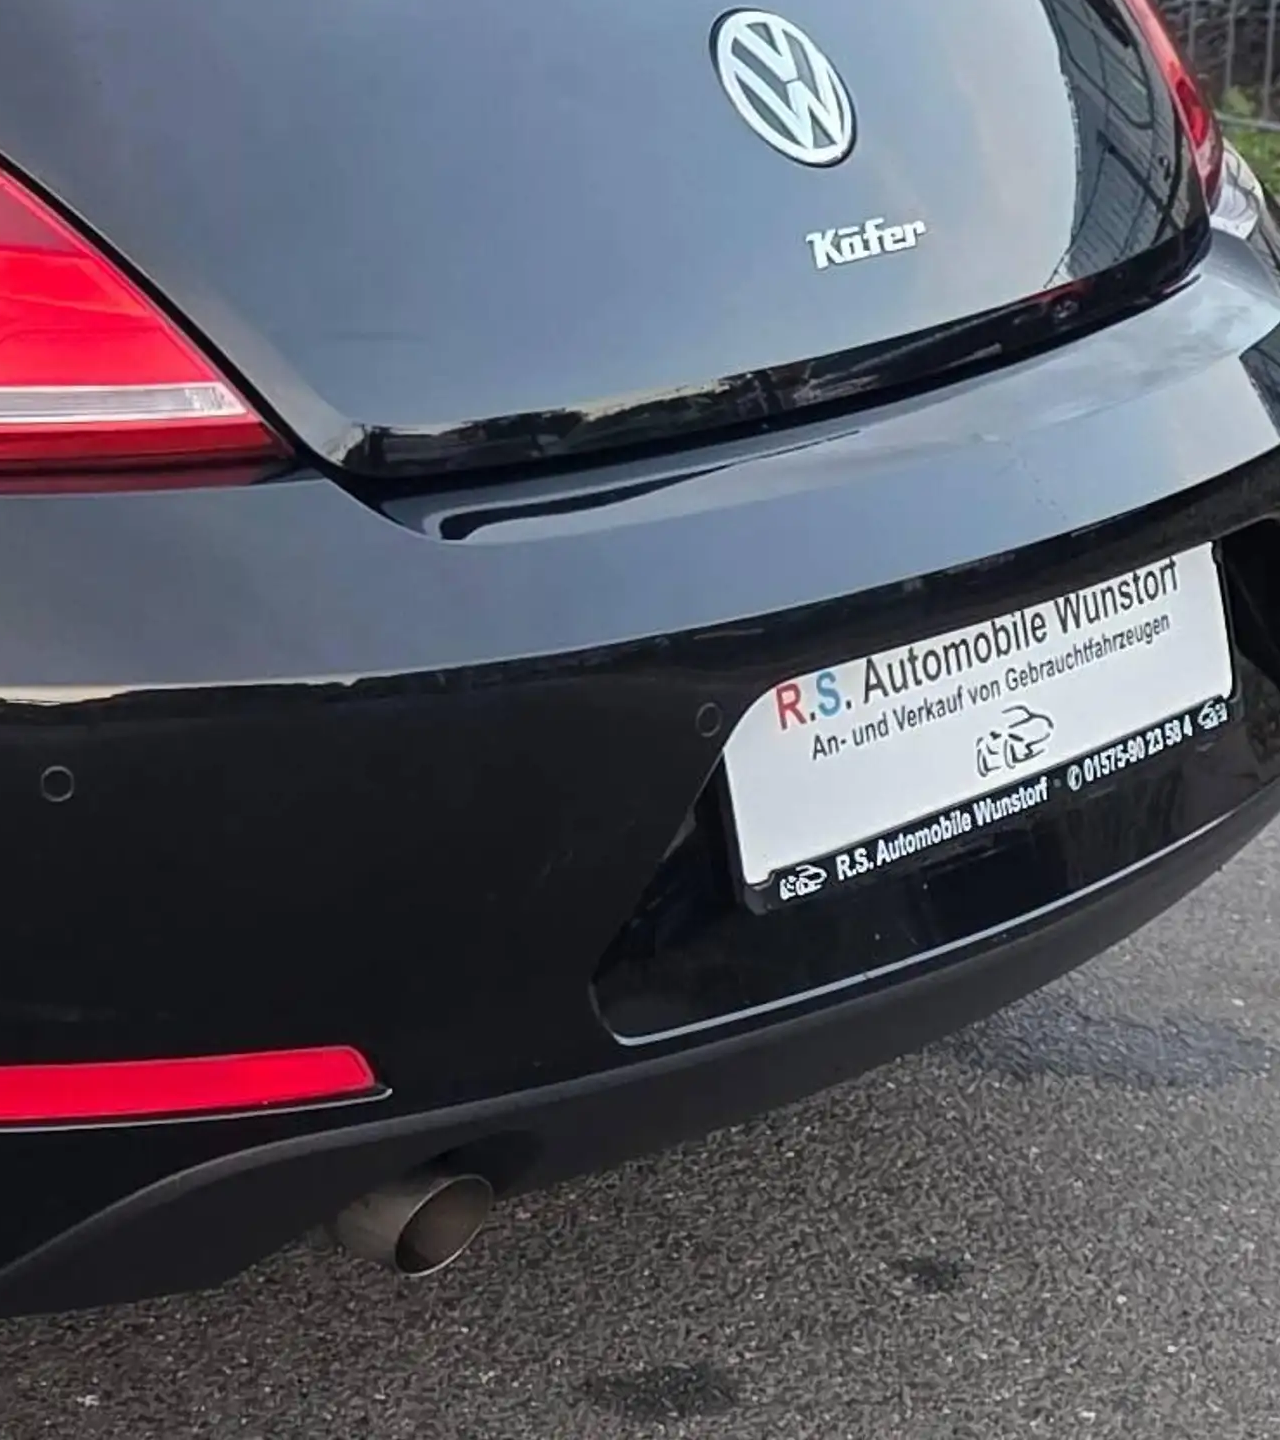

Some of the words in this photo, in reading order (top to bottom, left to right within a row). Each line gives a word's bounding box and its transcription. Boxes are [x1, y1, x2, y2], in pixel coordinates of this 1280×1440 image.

[717, 13, 852, 162] VW
[805, 217, 927, 270] Käfer
[775, 670, 852, 731] R.S.
[863, 610, 1047, 704] Automobile
[1054, 556, 1178, 635] Wunstorf
[812, 733, 847, 761] An-
[852, 711, 889, 747] und
[893, 684, 964, 732] Verkauf
[968, 679, 1001, 704] von
[1005, 613, 1171, 692] Gebrauchtfahrzeugen
[835, 847, 875, 881] R.S.
[876, 810, 973, 867] Automobile
[973, 775, 1048, 827] Wunstorf
[1146, 727, 1164, 756] 23
[1182, 714, 1193, 737] 4
